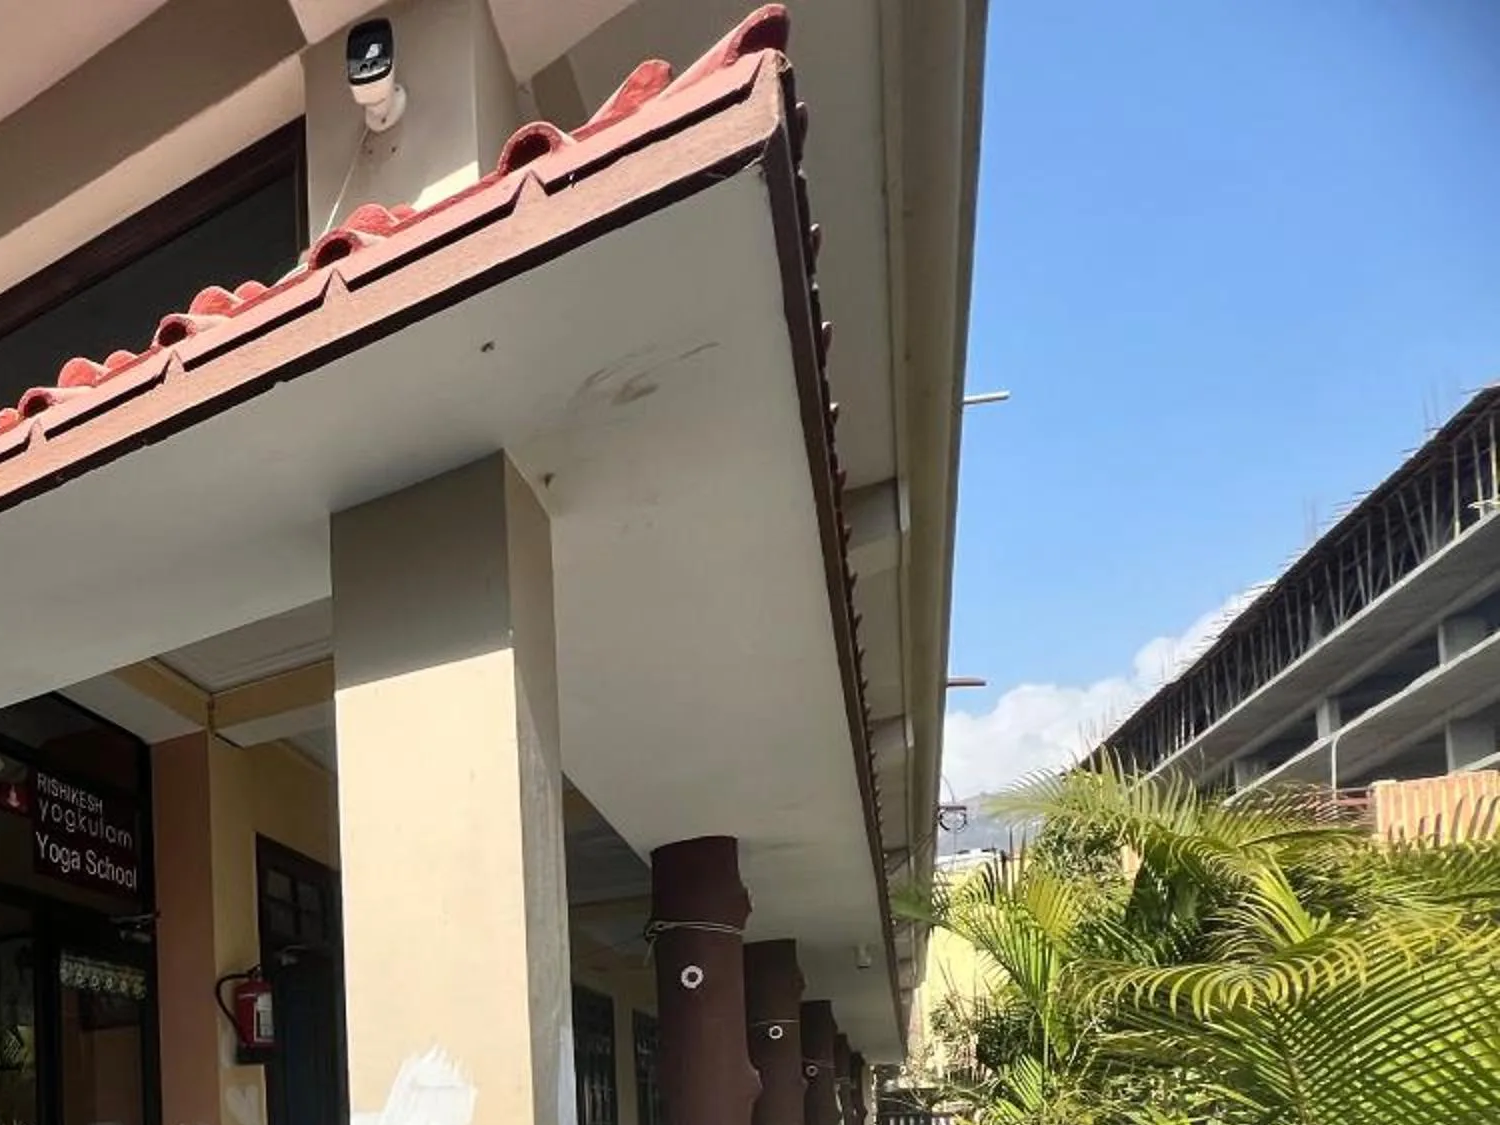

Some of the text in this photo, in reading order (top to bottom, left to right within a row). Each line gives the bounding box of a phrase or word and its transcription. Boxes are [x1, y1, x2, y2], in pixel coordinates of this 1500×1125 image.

[37, 773, 103, 814] RISHIKESH
[35, 831, 138, 892] Yoga School
